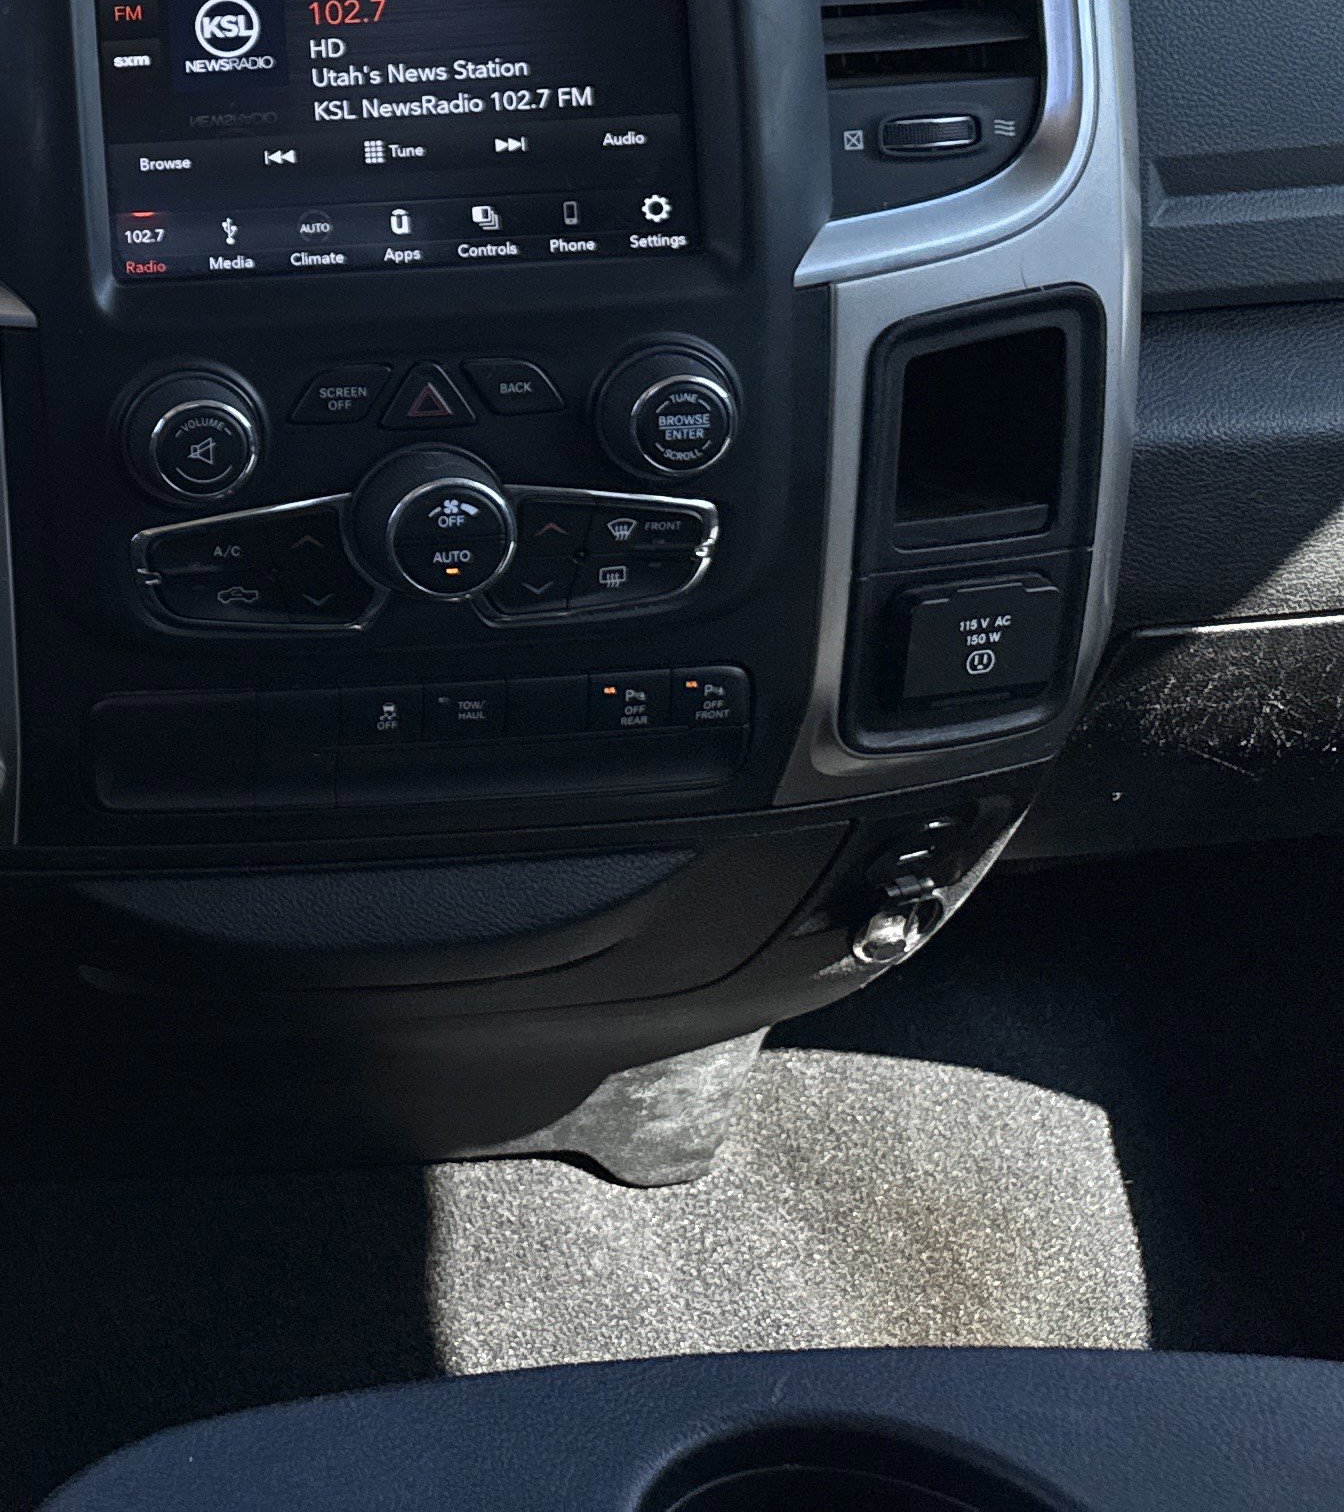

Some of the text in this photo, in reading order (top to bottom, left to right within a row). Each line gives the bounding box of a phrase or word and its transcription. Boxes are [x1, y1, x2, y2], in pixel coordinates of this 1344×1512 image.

[113, 4, 144, 21] FM
[202, 15, 256, 39] KSL
[309, 39, 347, 59] HD
[184, 55, 275, 74] NEWSRADIO
[311, 59, 530, 87] Utah's News Station
[313, 86, 594, 122] KSL NewsRadio 102.7 FM
[602, 132, 646, 146] Audio
[388, 144, 425, 158] Tune
[139, 157, 192, 171] Browse
[299, 222, 331, 234] AUTO
[124, 228, 165, 244] 102.7
[629, 234, 687, 250] Settings
[457, 242, 518, 258] Controls
[549, 239, 596, 253] Phone
[290, 251, 346, 266] Climate
[383, 248, 421, 263] Apps
[125, 259, 167, 274] Radio
[209, 256, 255, 270] Media
[319, 387, 367, 399] SCREEN
[499, 382, 532, 394] BACK
[669, 392, 699, 403] TUNE
[328, 399, 353, 411] OFF
[181, 417, 225, 432] VOLUME
[658, 413, 710, 426] BROWSE
[665, 428, 704, 441] ENTER
[662, 448, 703, 461] SCROLL
[437, 515, 465, 528] OFF
[644, 519, 682, 532] FRONT
[213, 544, 242, 558] A/C
[433, 550, 471, 563] AUTO
[959, 615, 1012, 632] 115 V AC
[966, 631, 1002, 646] 150 W
[624, 705, 646, 715] OFF
[703, 699, 724, 710] OFF
[458, 710, 485, 720] HAUL
[620, 715, 649, 726] REAR
[695, 709, 730, 720] FRONT
[376, 720, 398, 731] OFF
